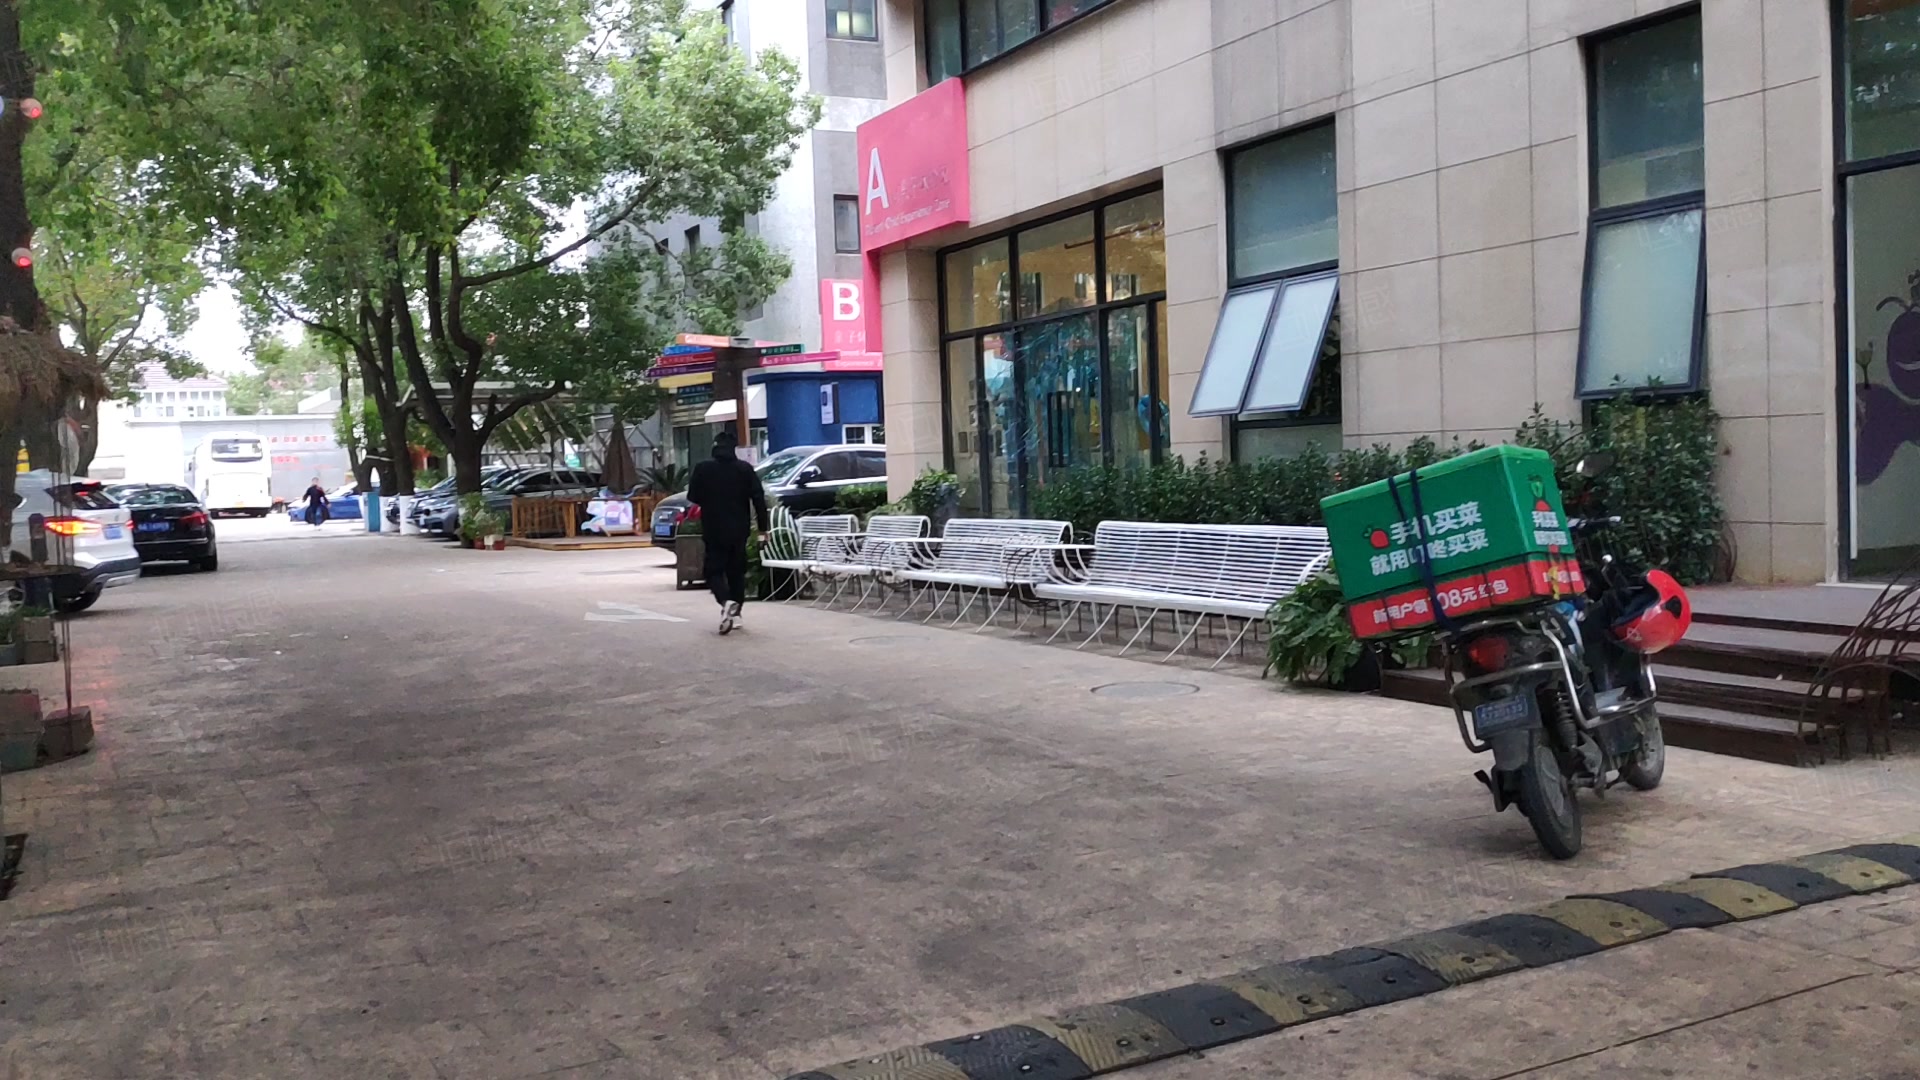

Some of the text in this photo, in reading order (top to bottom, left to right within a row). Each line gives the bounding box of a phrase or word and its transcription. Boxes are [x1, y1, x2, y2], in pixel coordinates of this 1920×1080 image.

[865, 147, 890, 215] A
[832, 282, 861, 321] B
[1390, 501, 1482, 544] 手机买菜
[1373, 579, 1510, 624] 新用户领08元红包
